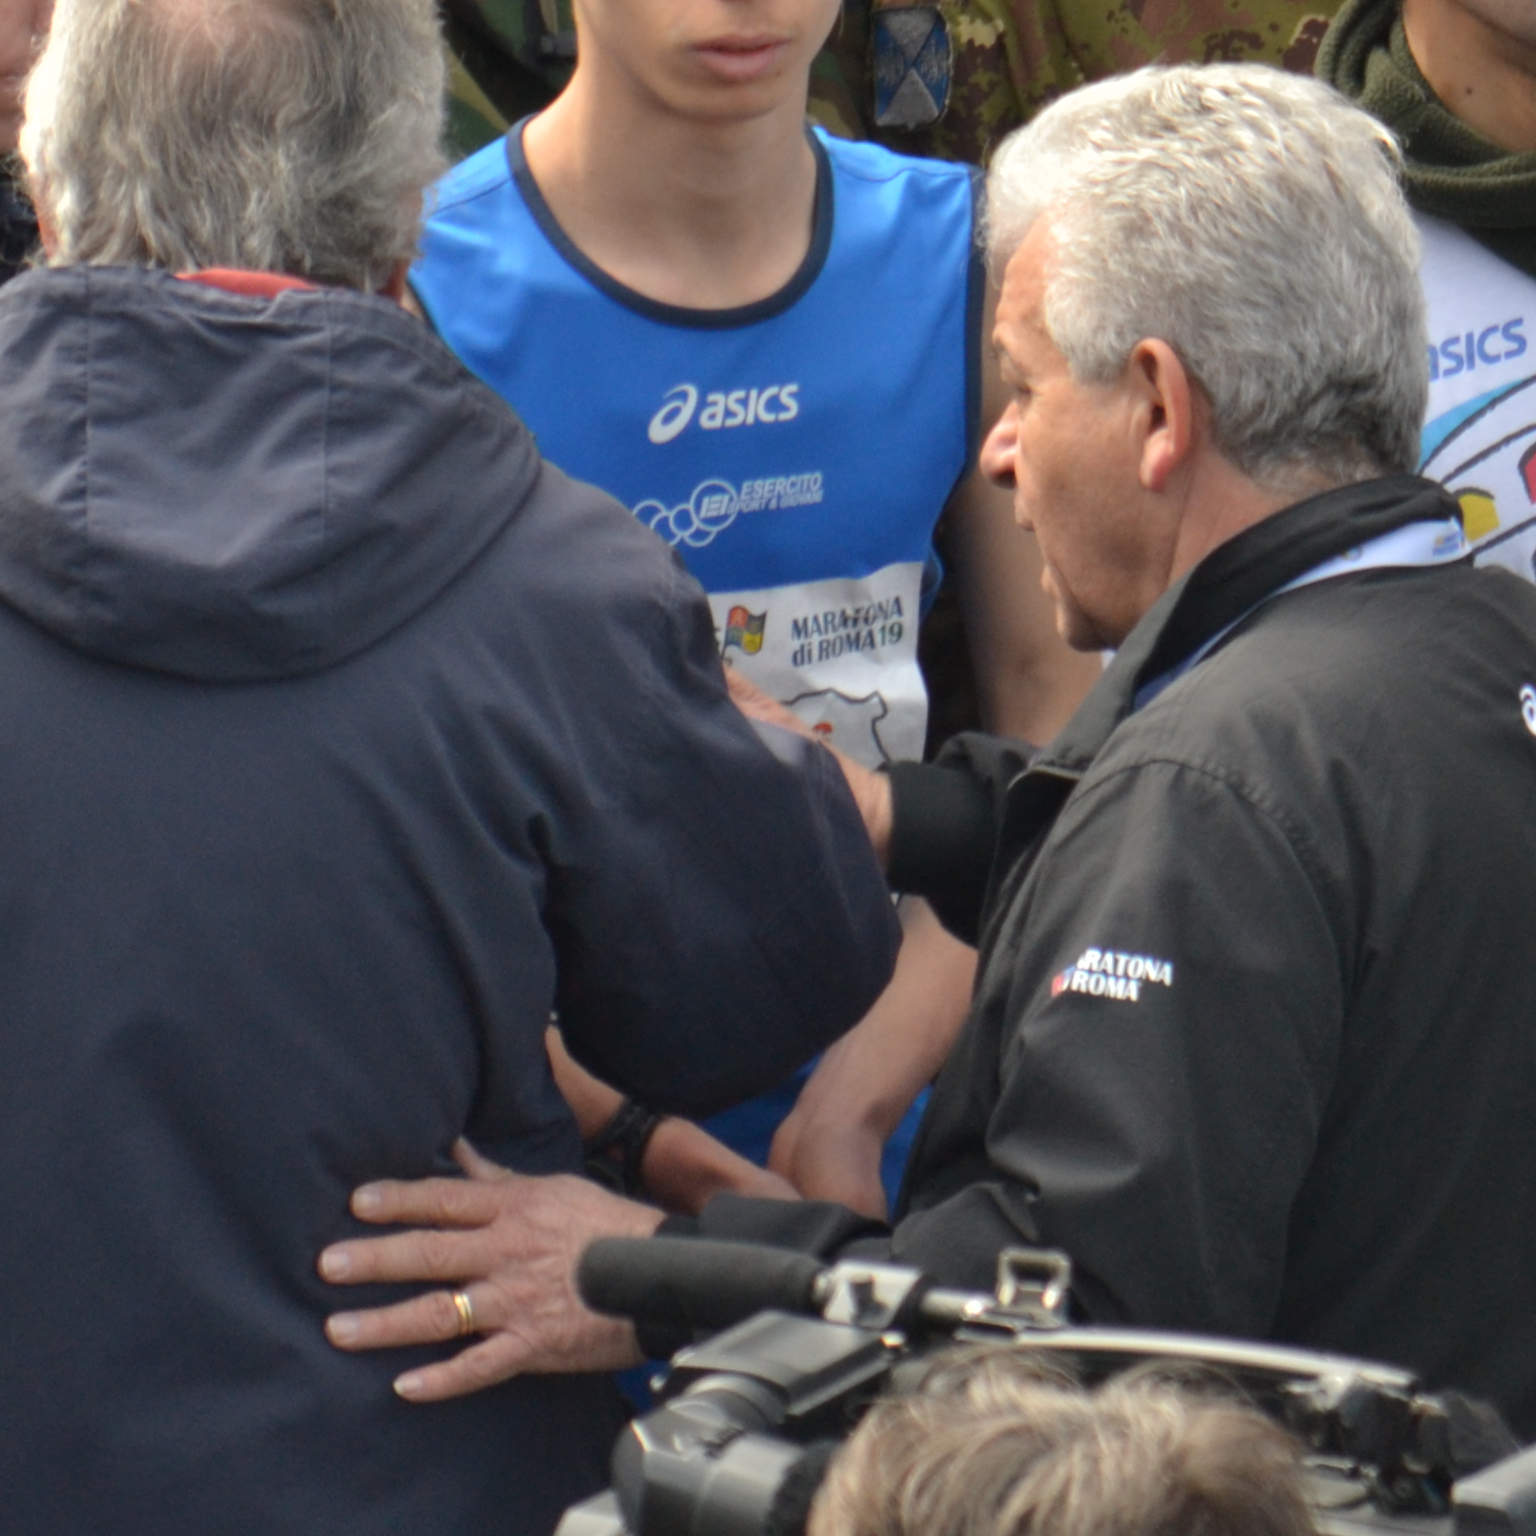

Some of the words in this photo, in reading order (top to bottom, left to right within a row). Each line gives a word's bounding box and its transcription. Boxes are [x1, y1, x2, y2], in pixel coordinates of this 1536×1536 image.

[699, 383, 799, 431] asics
[739, 472, 822, 501] ESERCITO
[790, 595, 905, 642] MARATONA
[791, 642, 813, 668] di
[817, 628, 877, 663] ROMA
[879, 621, 904, 648] 19
[1069, 970, 1139, 1002] ROMA
[1076, 948, 1173, 987] RATONA
